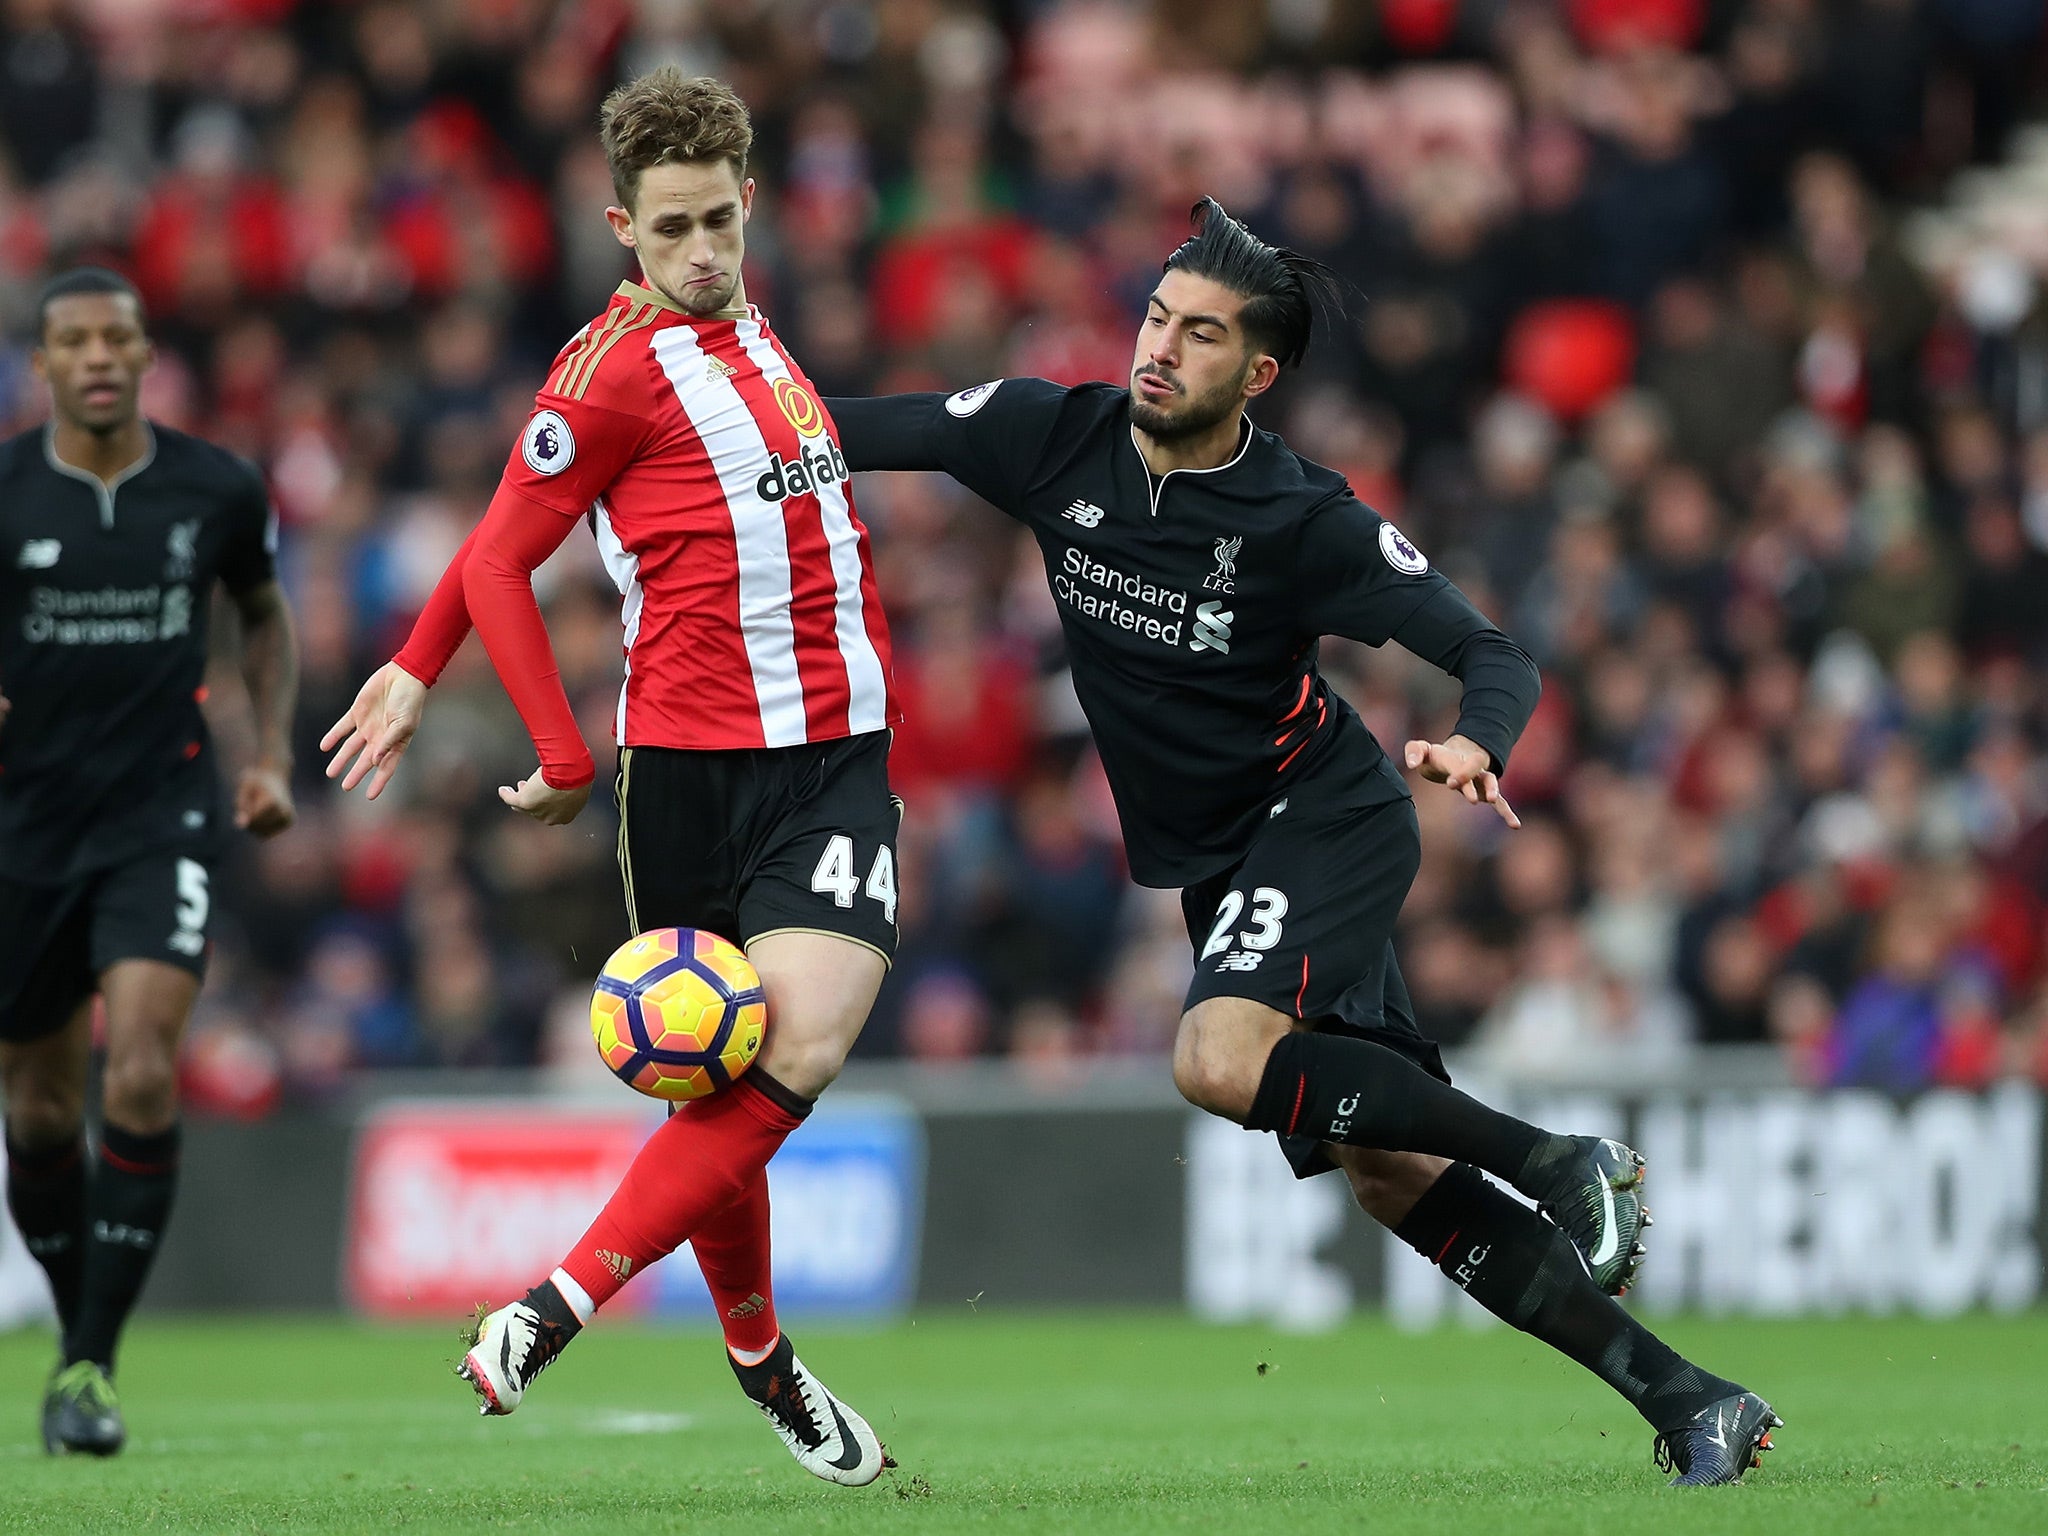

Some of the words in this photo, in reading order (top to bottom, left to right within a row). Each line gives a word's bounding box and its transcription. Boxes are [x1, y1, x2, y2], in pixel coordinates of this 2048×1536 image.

[706, 366, 739, 382] adidas
[757, 439, 847, 503] dafab
[1055, 574, 1183, 647] Chartered
[1063, 547, 1187, 615] Standard
[1202, 575, 1236, 595] L.F.C.
[175, 857, 209, 930] 5
[811, 834, 898, 926] 44
[1200, 887, 1290, 962] 23
